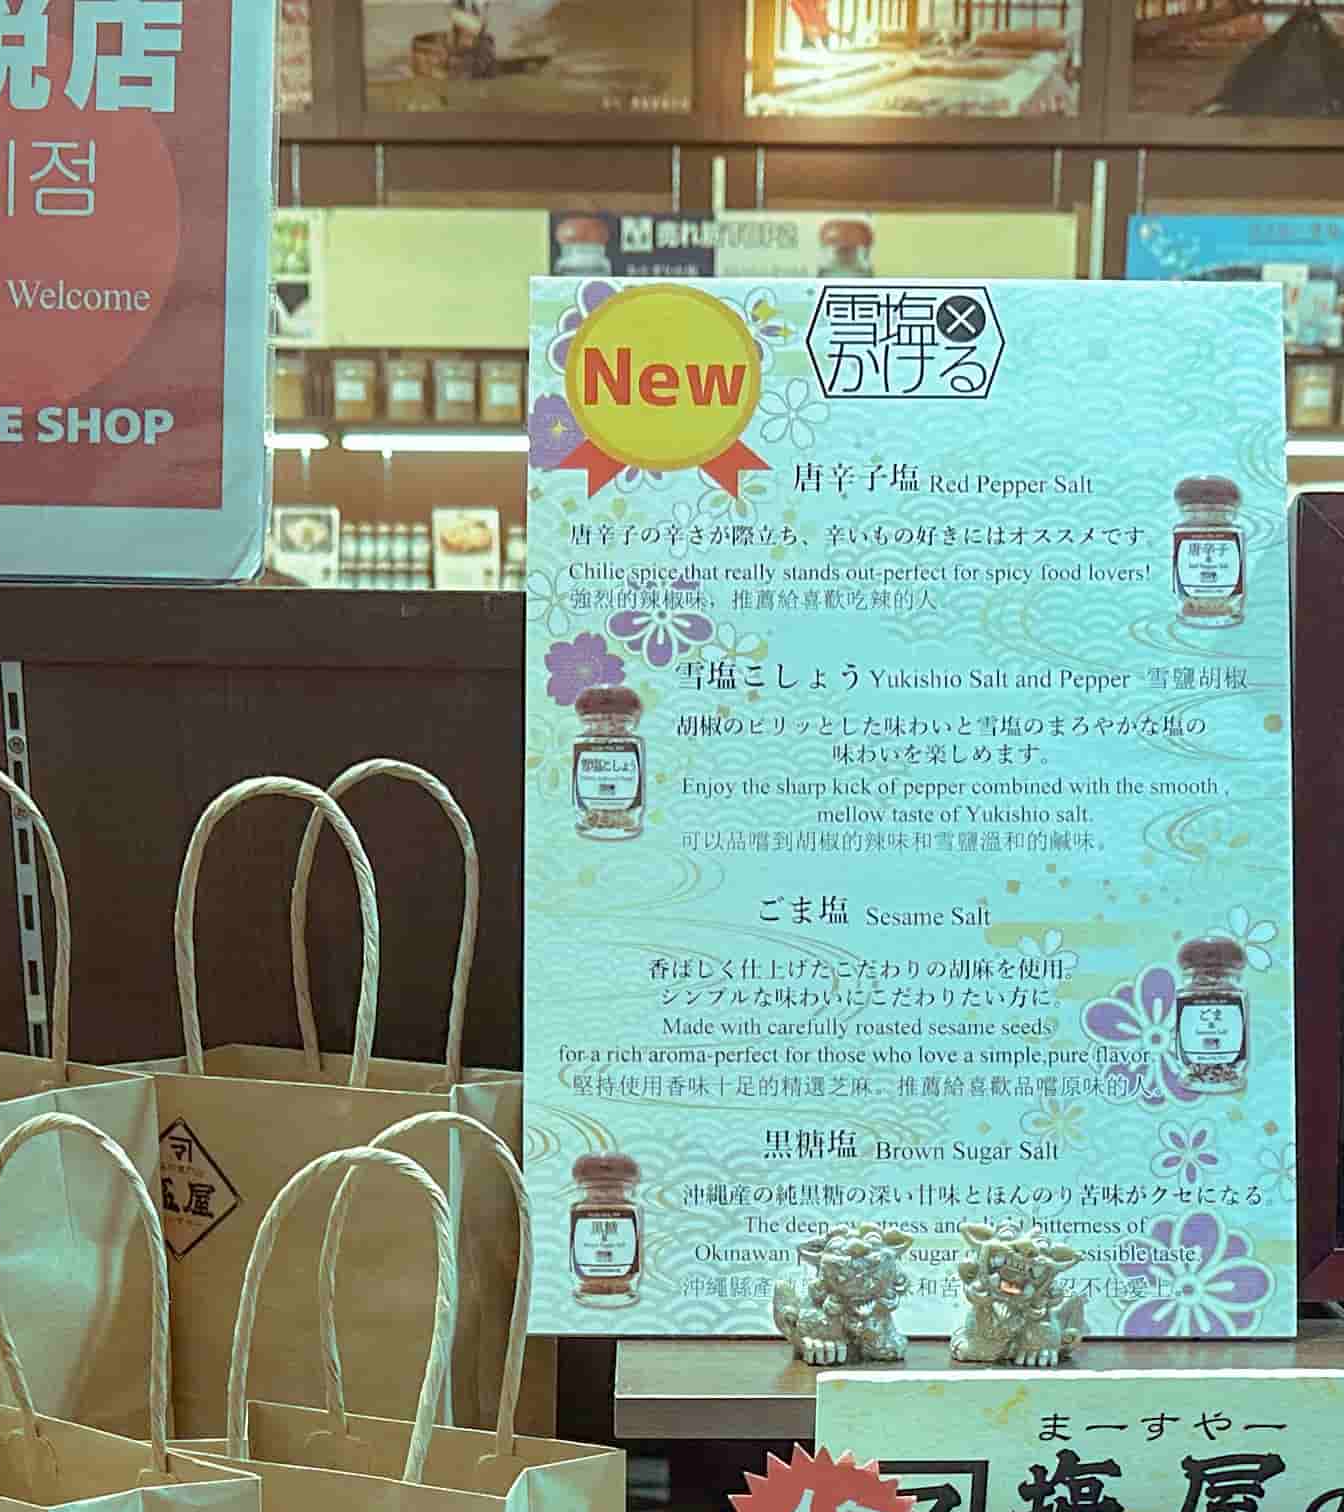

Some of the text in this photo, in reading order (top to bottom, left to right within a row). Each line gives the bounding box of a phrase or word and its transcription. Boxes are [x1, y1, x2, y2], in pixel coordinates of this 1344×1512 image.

[8, 279, 152, 314] Welcome
[582, 347, 747, 407] New
[35, 406, 175, 446] SHOP
[793, 463, 1094, 498] 唐辛子塩 Red Pepper Salt
[630, 563, 678, 586] spice
[684, 563, 718, 582] that
[725, 562, 776, 586] really
[783, 562, 840, 582] stands
[845, 563, 947, 586] out-perfect
[953, 563, 979, 582] for
[985, 563, 1033, 586] spicy
[1040, 563, 1080, 582] food
[1086, 563, 1150, 583] lovers!
[675, 663, 861, 692] 雪塩こしょう
[870, 666, 963, 691] Yukishio
[968, 667, 1008, 691] Salt
[1013, 667, 1052, 691] and
[1058, 667, 1130, 695] Pepper
[832, 743, 1048, 765] 味わいを楽しめます。
[682, 777, 735, 798] Enjoy
[743, 777, 770, 795] the
[776, 777, 826, 799] sharp
[832, 777, 871, 795] kick
[878, 777, 897, 795] of
[904, 782, 965, 800] pepper
[972, 777, 1062, 795] combined
[1069, 777, 1108, 795] with
[1116, 777, 1143, 795] the
[817, 805, 1093, 823] mellow taste of Yukishio salt.
[758, 895, 991, 927] ごま塩 Sesame Salt
[662, 1017, 1051, 1040] Made with carefully roasted sesame seeds
[559, 1045, 584, 1063] for
[590, 1051, 600, 1063] a
[607, 1045, 641, 1063] rich
[648, 1045, 777, 1067] aroma-perfect
[785, 1045, 808, 1063] for
[818, 1045, 865, 1063] those
[873, 1045, 911, 1063] who
[919, 1046, 960, 1064] love
[964, 1051, 973, 1064] a
[763, 1129, 1058, 1165] 黒糖塩 Brown Sugar Salt
[745, 1216, 779, 1233] The
[785, 1216, 828, 1237] deep
[1032, 1215, 1120, 1233] bitterness
[1127, 1215, 1147, 1233] of
[695, 1243, 790, 1263] Okinawan
[910, 1250, 957, 1267] sugar
[1039, 1412, 1288, 1443] まーすやー
